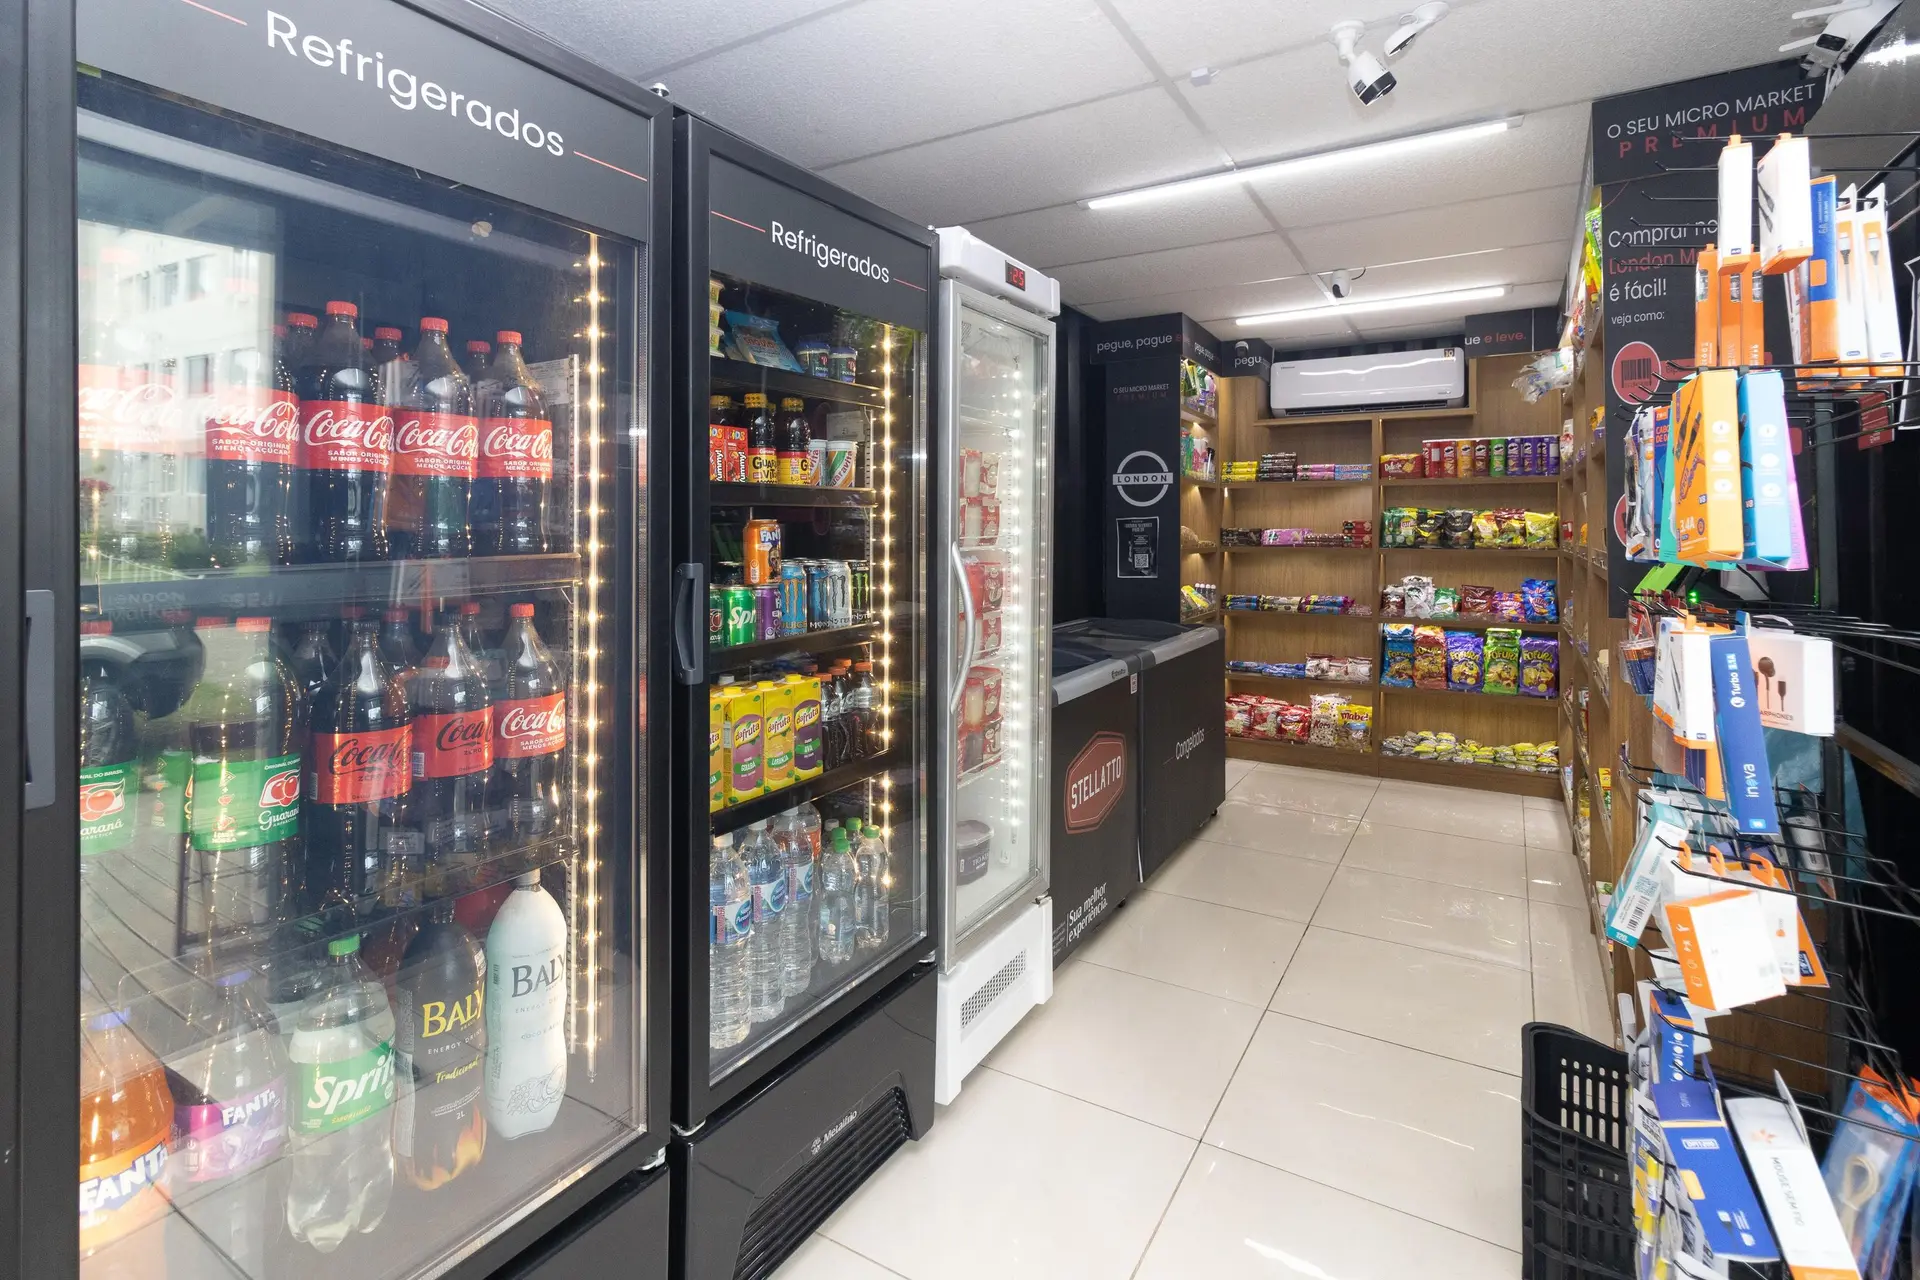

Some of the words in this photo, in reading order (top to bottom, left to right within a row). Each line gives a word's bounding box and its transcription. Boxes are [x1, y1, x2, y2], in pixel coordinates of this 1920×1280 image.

[266, 9, 565, 158] Refrigerados
[1607, 123, 1621, 139] O
[1627, 115, 1660, 135] SEU
[1665, 102, 1729, 127] MICRO
[1736, 83, 1816, 114] MARKET
[771, 220, 890, 284] Refrigerados
[1609, 283, 1620, 302] é
[1624, 278, 1667, 300] fácil!
[1611, 312, 1632, 327] veja
[1633, 309, 1665, 324] como:
[1096, 339, 1134, 354] pegue,
[1135, 333, 1173, 352] pague
[1464, 334, 1481, 346] ue
[1484, 334, 1493, 344] e
[1495, 330, 1527, 344] leve.
[1234, 355, 1262, 368] pegu
[1118, 386, 1129, 394] SEU
[1129, 384, 1148, 394] MICRO
[1148, 383, 1170, 391] MARKET
[212, 438, 247, 446] SABOR
[214, 444, 251, 453] MENOS
[327, 449, 359, 458] SABOR
[414, 457, 442, 465] SABOR
[1117, 474, 1168, 484] LONDON
[1730, 671, 1741, 696] Turbo
[767, 716, 791, 733] dafruta
[796, 707, 820, 725] dafruta
[1760, 709, 1794, 722] ARPHONES
[735, 723, 760, 742] dafruta
[1175, 726, 1205, 761] Congelados
[1070, 755, 1122, 810] STELLATTO
[1743, 763, 1760, 798] inova
[80, 818, 125, 836] araná
[1069, 906, 1083, 927] Sua
[1083, 882, 1107, 913] melhor
[511, 947, 566, 998] BALY
[421, 981, 485, 1038] BALY
[427, 1041, 462, 1055] ENERGY
[435, 1054, 480, 1084] Tradicional
[220, 1088, 277, 1128] FANTA
[80, 1140, 169, 1212] FANTA
[1771, 1156, 1791, 1190] MOUSE
